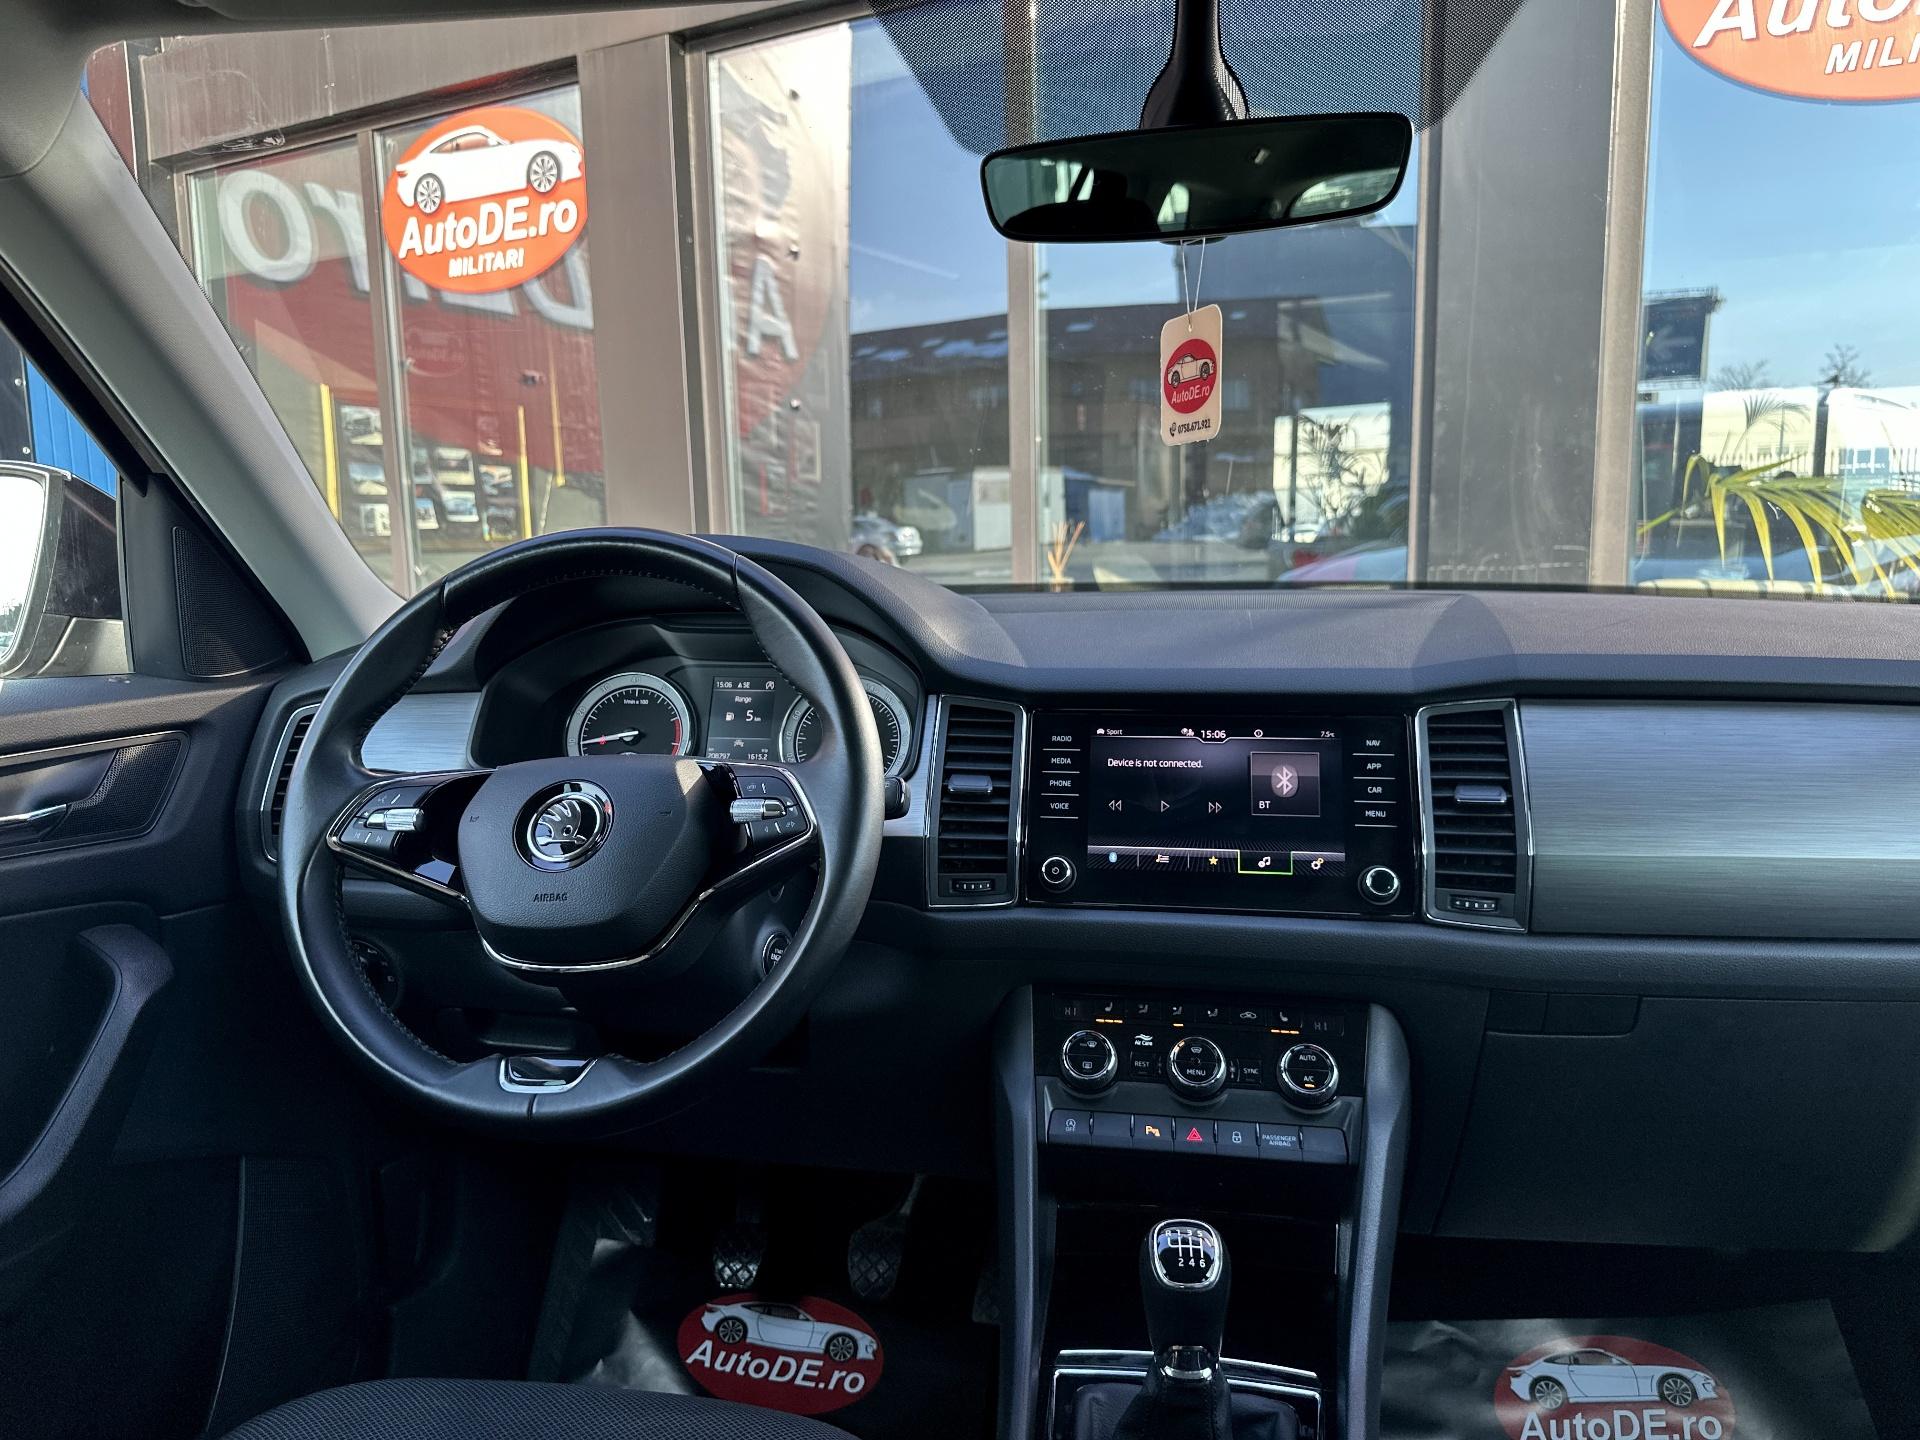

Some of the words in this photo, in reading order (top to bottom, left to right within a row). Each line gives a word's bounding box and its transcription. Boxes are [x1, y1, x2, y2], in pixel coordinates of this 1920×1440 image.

[398, 196, 578, 259] AutoDE.ro
[448, 247, 525, 278] MILITARI
[1171, 384, 1210, 404] AutoDE.ro
[735, 695, 752, 704] Range
[745, 710, 754, 722] 5
[1106, 728, 1123, 736] Sport
[1200, 730, 1227, 739] 15:06
[1366, 739, 1381, 747] NAV
[1051, 757, 1072, 765] MEDIA
[1107, 758, 1134, 768] Device
[1135, 758, 1142, 768] is
[1143, 759, 1158, 768] not
[1158, 759, 1204, 769] connected.
[1366, 762, 1382, 770] APP
[1049, 779, 1072, 787] PHONE
[1367, 786, 1383, 794] CAR
[1050, 802, 1070, 810] VOICE
[1258, 800, 1271, 809] BT
[1365, 809, 1387, 818] MENU
[533, 892, 568, 903] AIRBAG
[1299, 1054, 1317, 1062] AUTO
[1186, 1068, 1206, 1076] MENU
[1243, 1067, 1259, 1075] SYNC
[1303, 1074, 1314, 1083] A/C
[1262, 1133, 1297, 1142] PASSENGER
[1268, 1139, 1292, 1147] AIRBAG
[1178, 1257, 1185, 1267] 2
[1188, 1258, 1196, 1267] 4
[1199, 1258, 1206, 1268] 6
[685, 1339, 866, 1394] AutoDE.ro
[1519, 1408, 1723, 1440] AutoDE.ro
